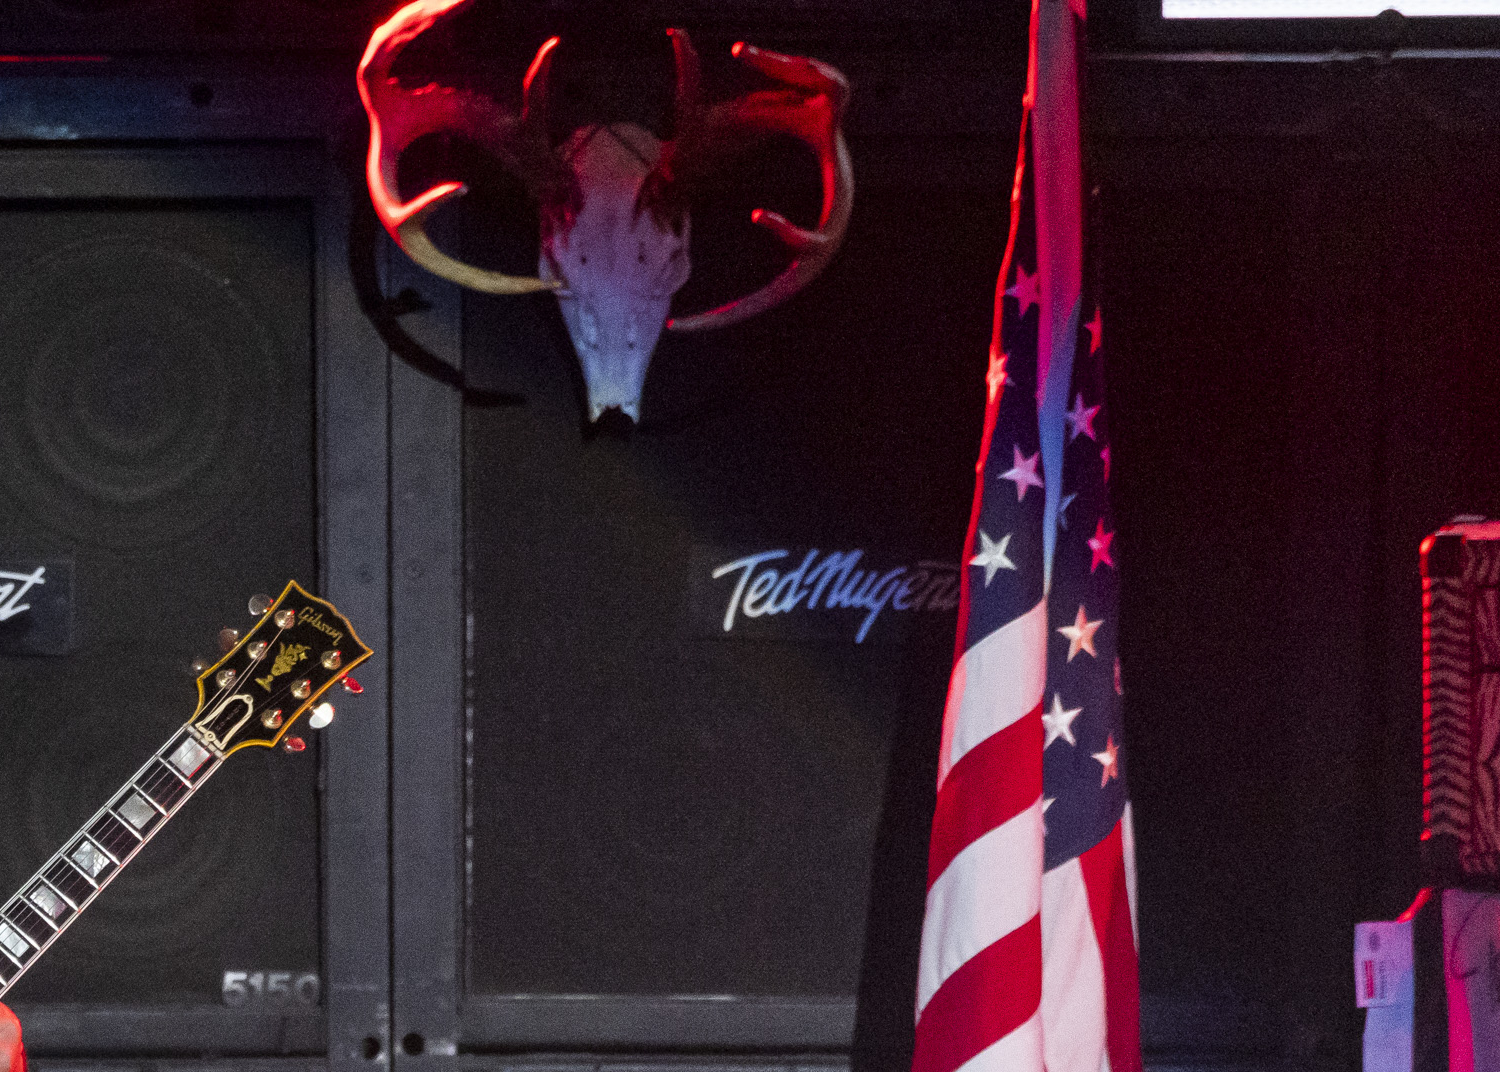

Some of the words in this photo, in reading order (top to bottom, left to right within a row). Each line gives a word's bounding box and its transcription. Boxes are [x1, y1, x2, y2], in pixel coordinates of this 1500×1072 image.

[711, 548, 820, 632] Ted
[297, 605, 345, 647] Gibson
[221, 970, 320, 1004] 5150
